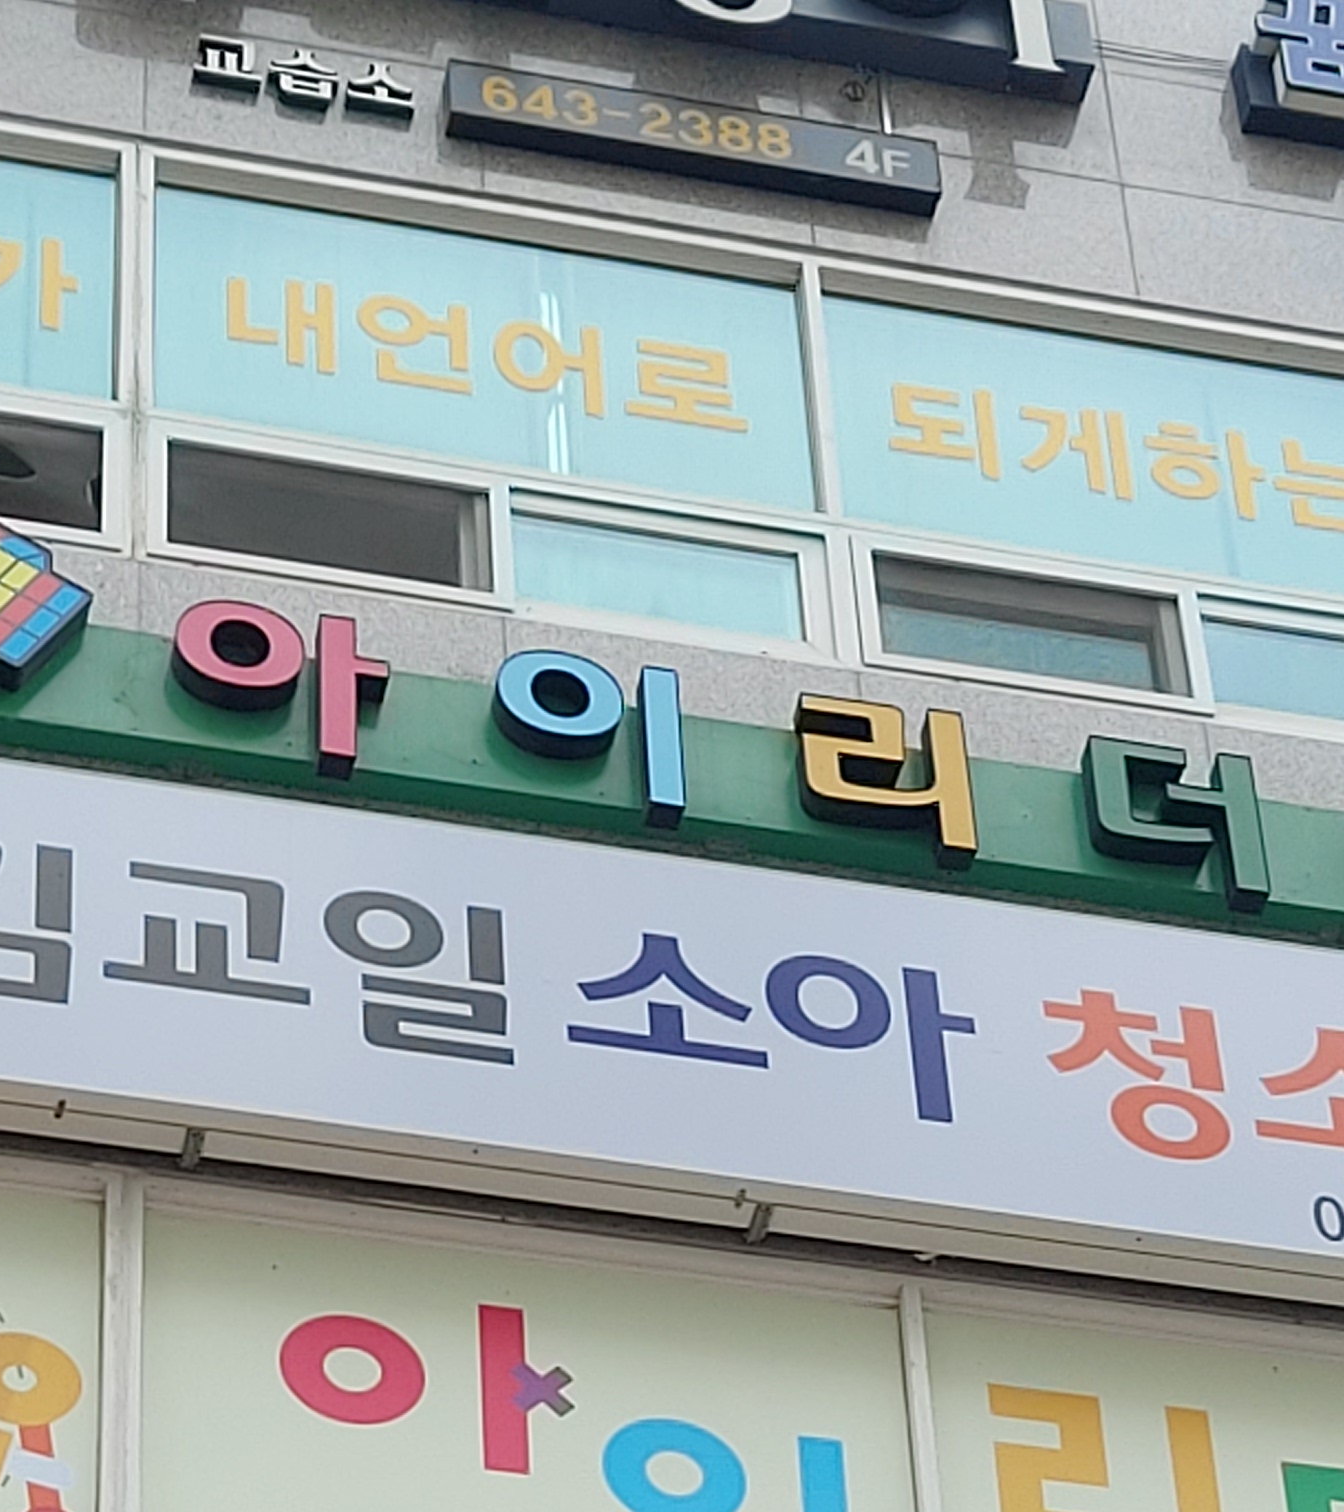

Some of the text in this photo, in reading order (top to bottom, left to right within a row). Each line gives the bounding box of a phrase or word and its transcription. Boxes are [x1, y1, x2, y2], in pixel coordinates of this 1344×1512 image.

[193, 34, 414, 113] 교습소
[481, 74, 911, 180] 643-2388 4F
[226, 276, 748, 432] 내언어로
[172, 599, 1271, 896] 아이리더
[567, 932, 977, 1124] 소아
